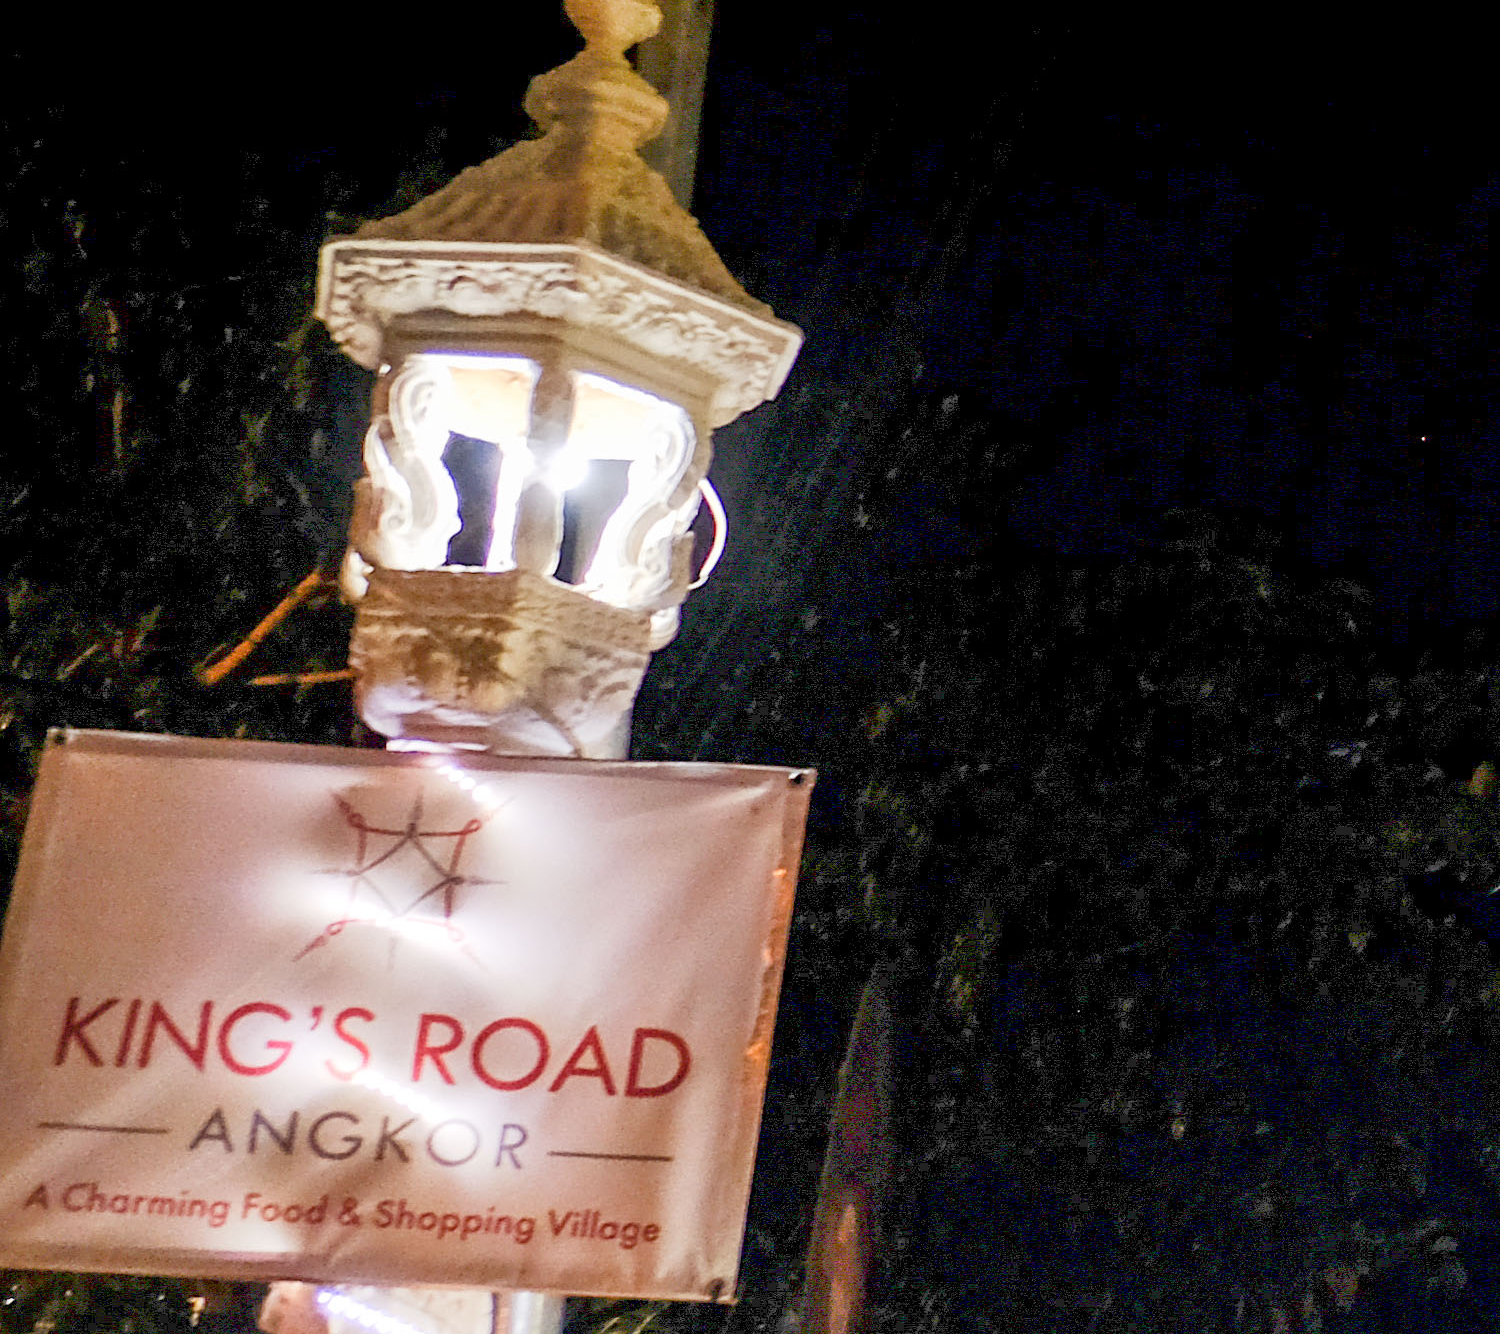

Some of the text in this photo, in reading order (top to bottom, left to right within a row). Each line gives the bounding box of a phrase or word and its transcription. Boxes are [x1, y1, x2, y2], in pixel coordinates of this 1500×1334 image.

[52, 996, 694, 1099] KING'S ROAD
[189, 1106, 529, 1171] ANGKOR
[24, 1183, 663, 1247] A Charming Food & Shopping Village
